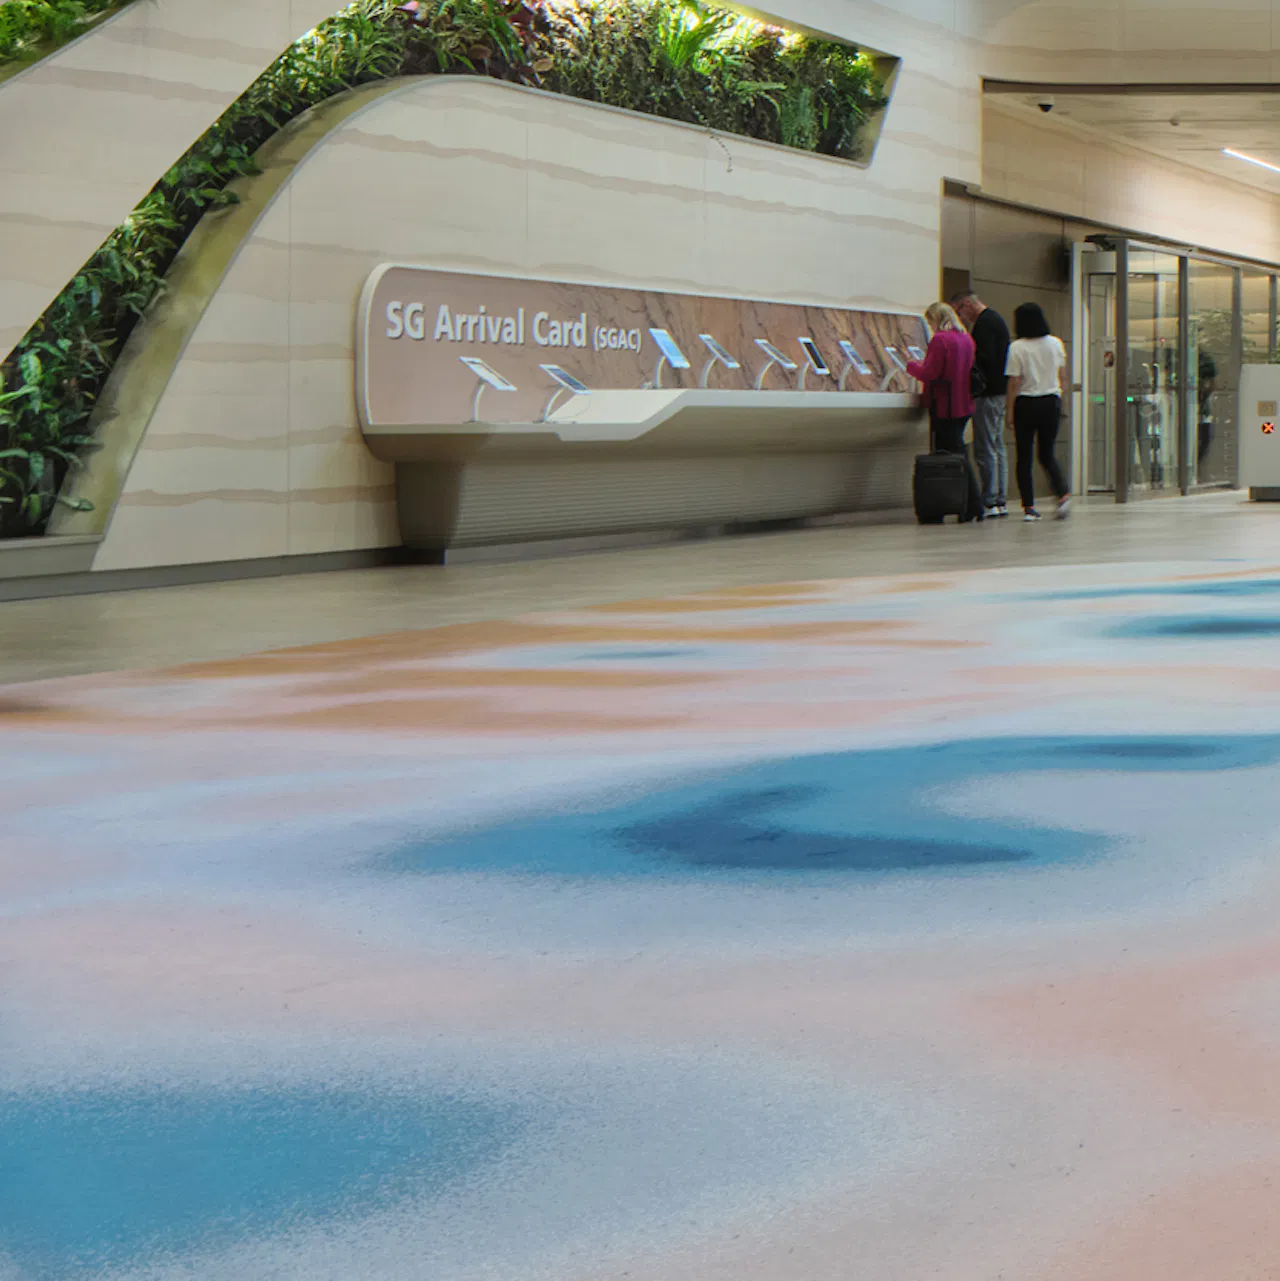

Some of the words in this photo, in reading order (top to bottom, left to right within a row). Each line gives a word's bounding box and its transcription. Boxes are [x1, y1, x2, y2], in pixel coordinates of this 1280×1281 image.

[386, 300, 425, 340] SG
[434, 304, 525, 344] Arrival
[532, 311, 587, 348] Card
[593, 324, 642, 354] (SGAC)
